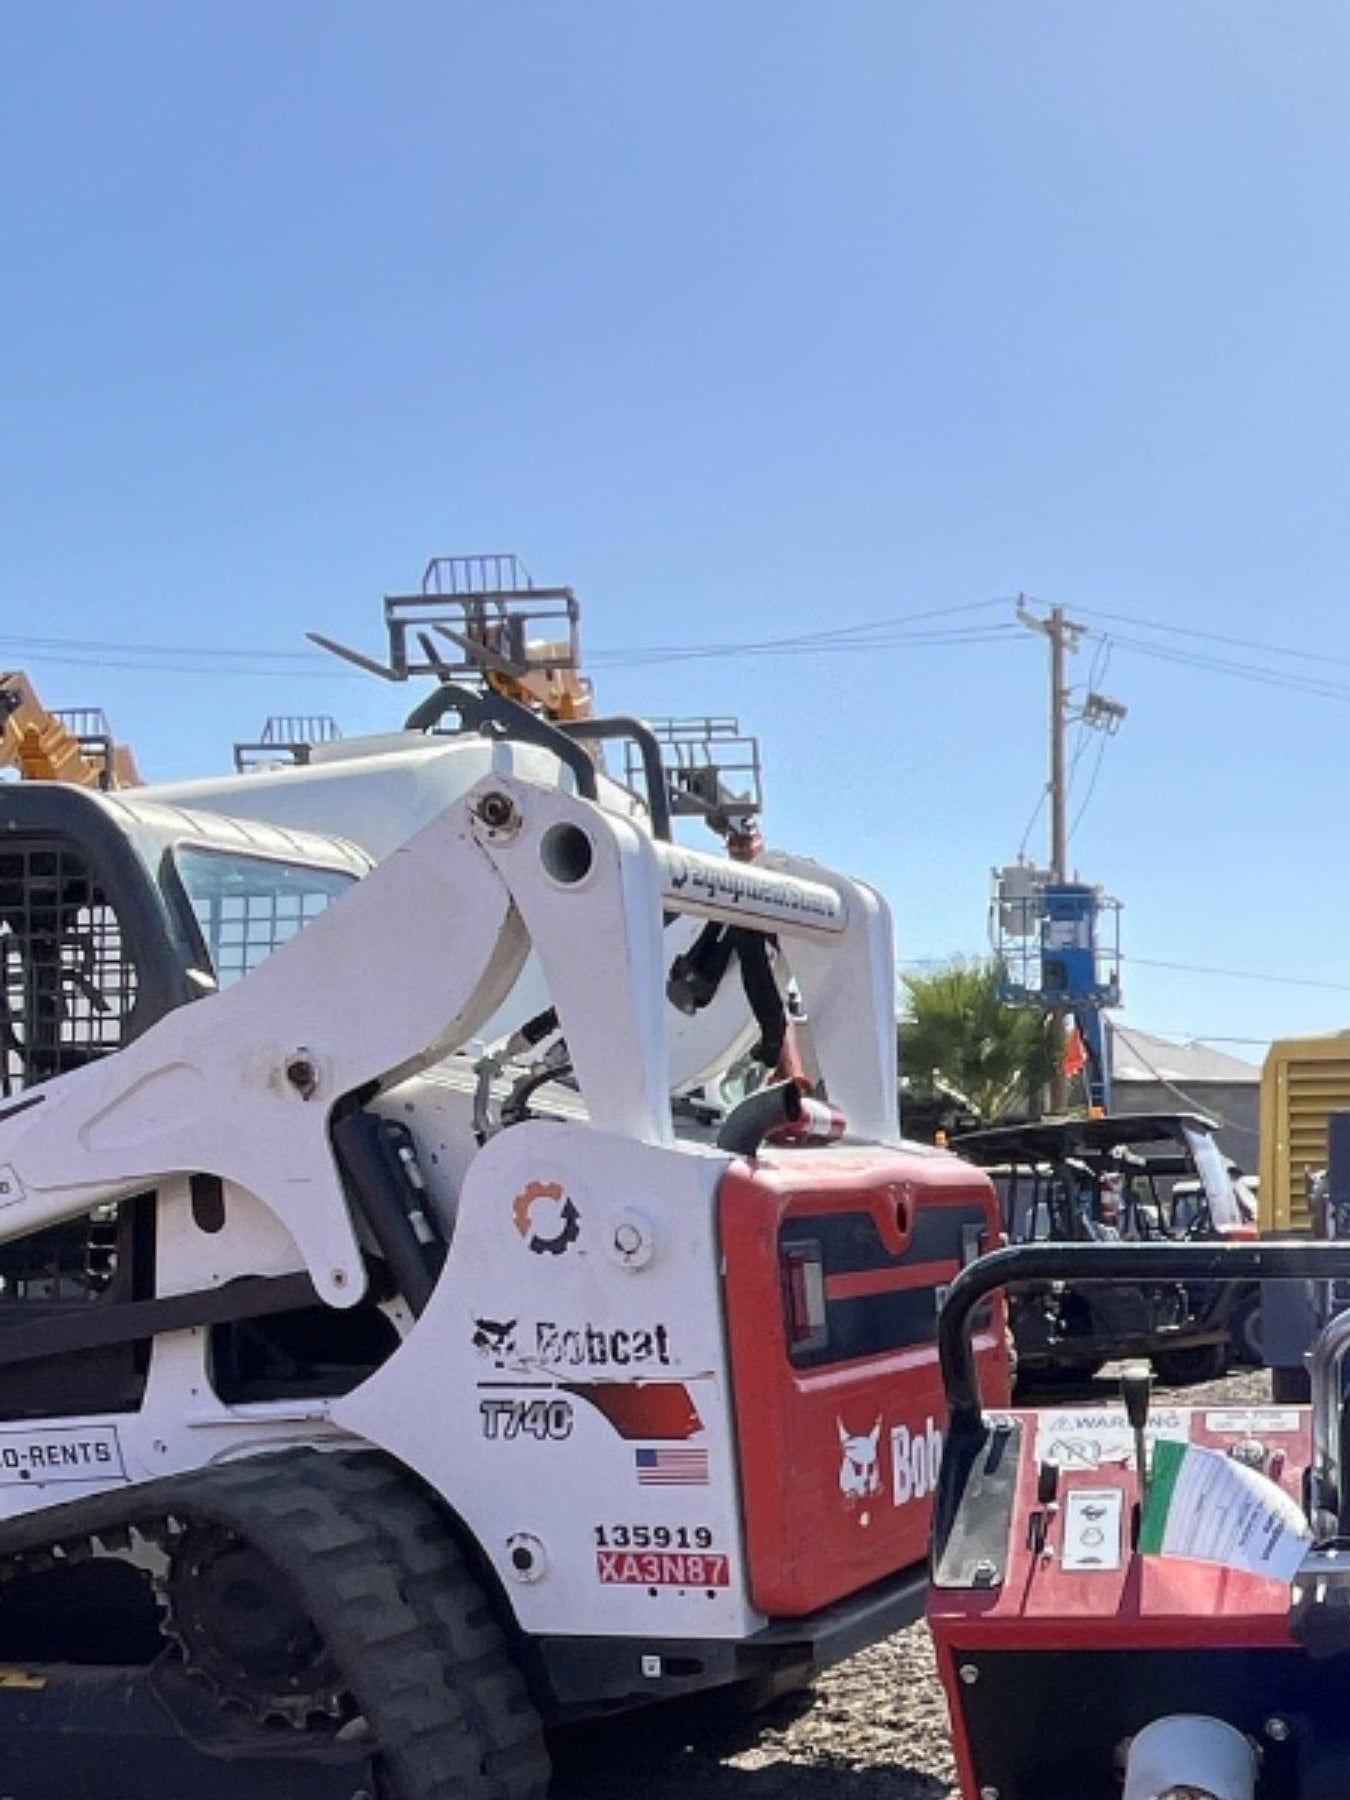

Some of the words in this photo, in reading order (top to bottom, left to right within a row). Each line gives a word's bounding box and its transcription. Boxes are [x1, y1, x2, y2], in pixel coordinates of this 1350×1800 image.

[480, 1399, 574, 1440] T740
[1075, 1413, 1180, 1430] WARNG
[0, 1442, 111, 1468] O-RENTS
[889, 1414, 944, 1507] Bob
[594, 1524, 713, 1549] 135919
[598, 1552, 725, 1584] XA3N87
